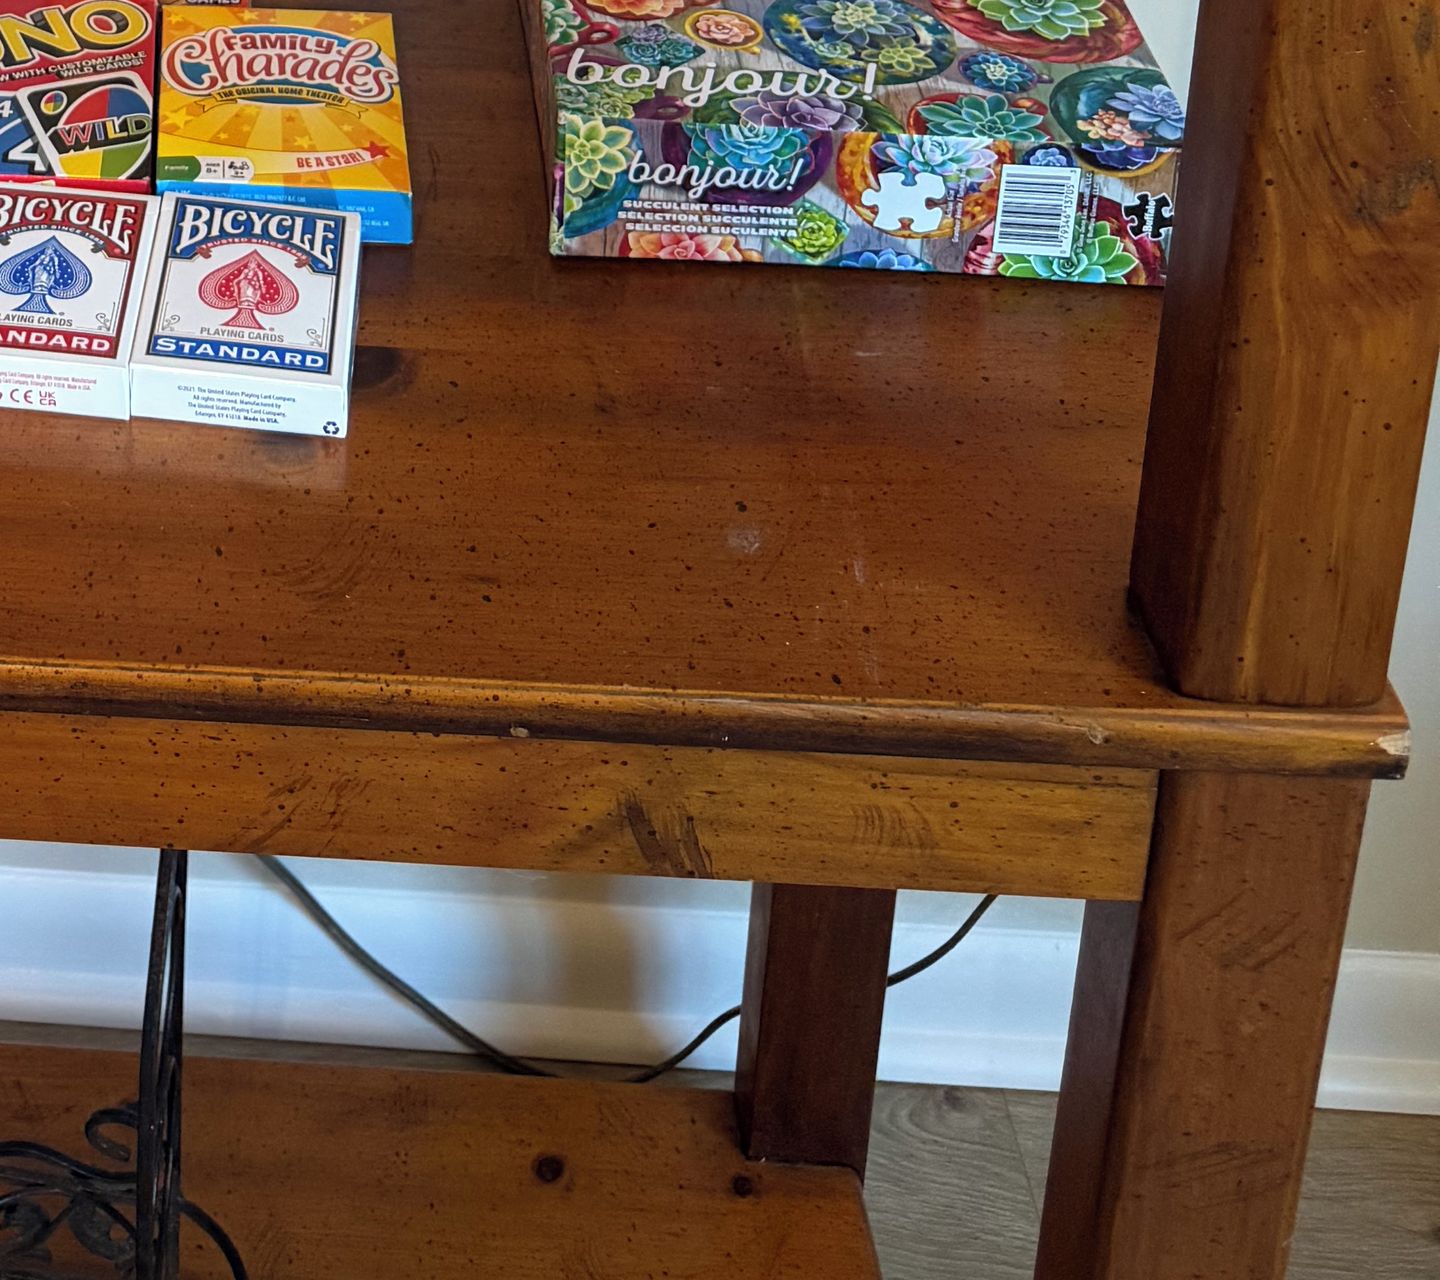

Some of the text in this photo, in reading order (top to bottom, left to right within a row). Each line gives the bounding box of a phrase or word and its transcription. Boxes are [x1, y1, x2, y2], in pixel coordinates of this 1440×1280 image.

[12, 67, 46, 80] WITH
[48, 51, 148, 74] CUSTOMIZABLE
[60, 58, 145, 77] WILD CARDS!
[165, 29, 396, 96] Charades
[566, 47, 878, 108] bonjour!
[59, 114, 152, 150] WILD
[296, 156, 314, 168] BE
[317, 156, 325, 167] A
[627, 150, 805, 199] bonjour!
[622, 200, 709, 212] SUCCULENT
[711, 203, 795, 215] SELECTION
[1142, 200, 1157, 232] Buffalo
[174, 205, 338, 269] BICYCLE
[37, 315, 73, 328] CARDS
[200, 326, 285, 343] PLAYING CARDS
[155, 337, 325, 369] STANDARD
